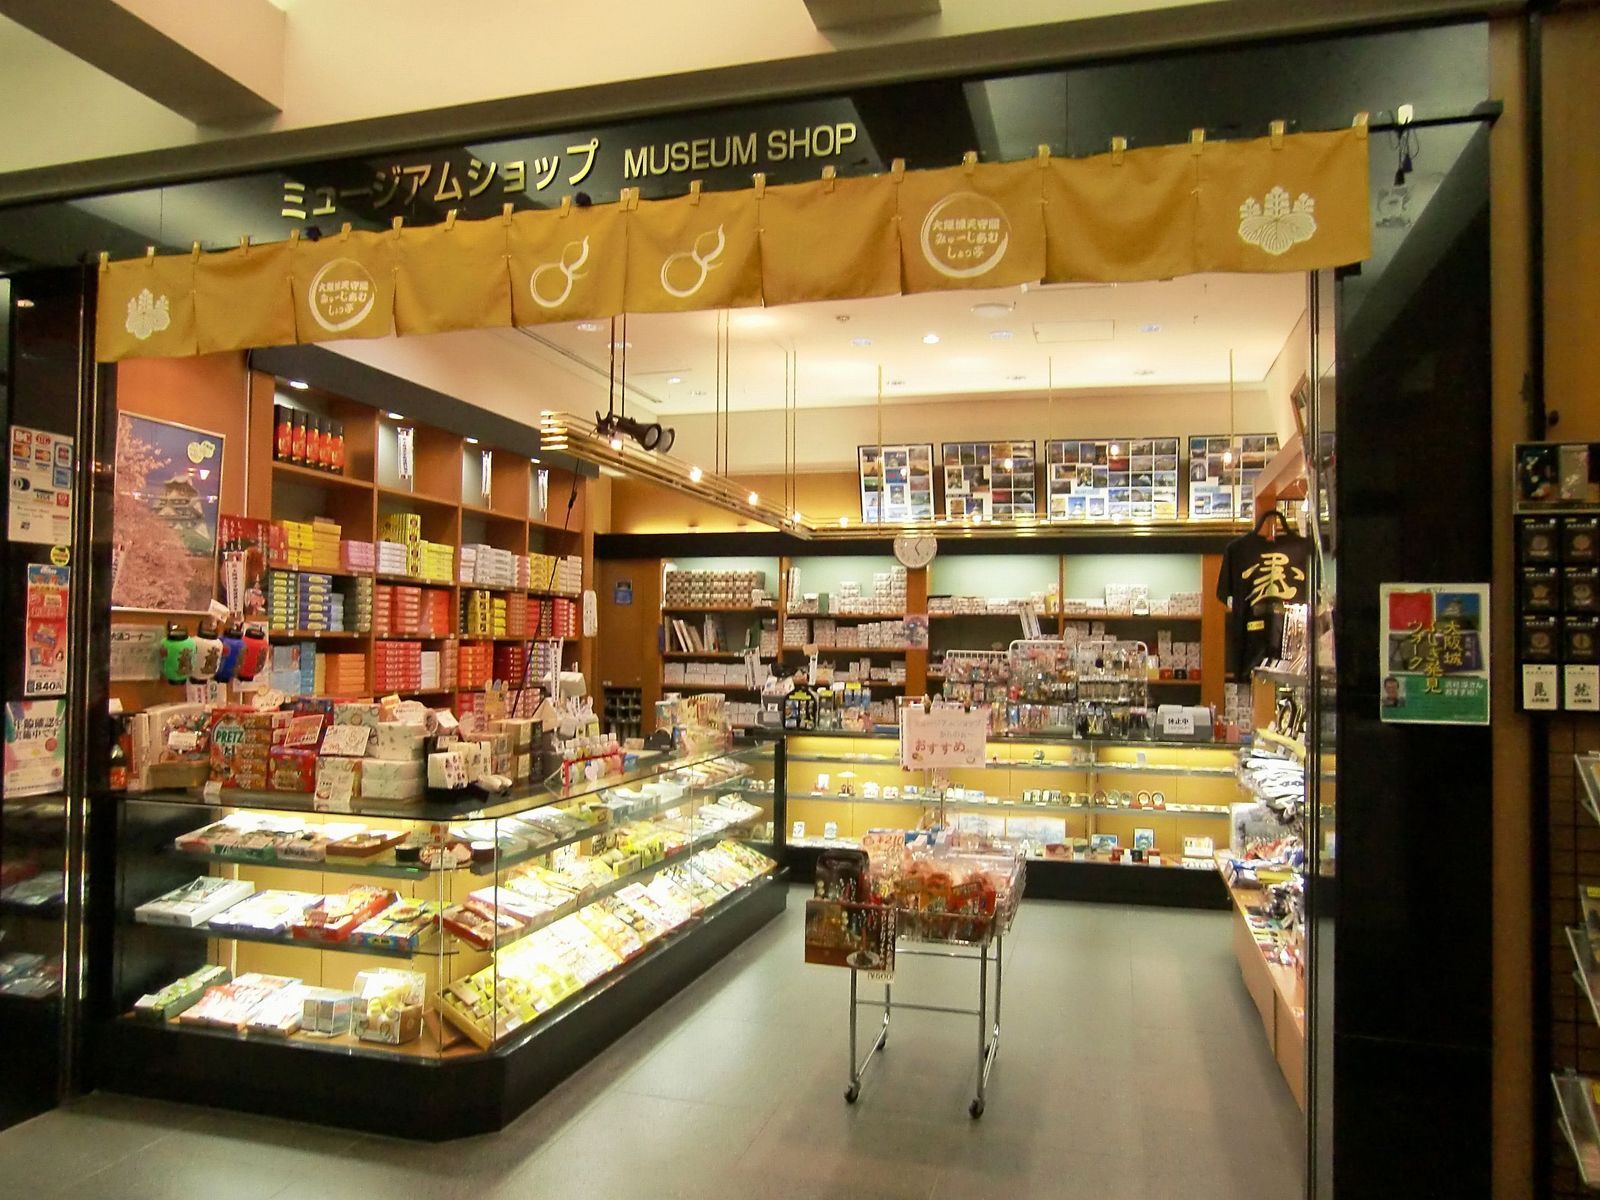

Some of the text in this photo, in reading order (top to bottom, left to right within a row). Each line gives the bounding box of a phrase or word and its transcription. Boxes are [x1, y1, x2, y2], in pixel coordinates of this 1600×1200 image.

[624, 122, 857, 180] MUSEUM SHOP
[281, 137, 601, 221] ミュージアムショップ
[215, 730, 244, 744] PRETZ
[915, 738, 967, 756] おすすめ
